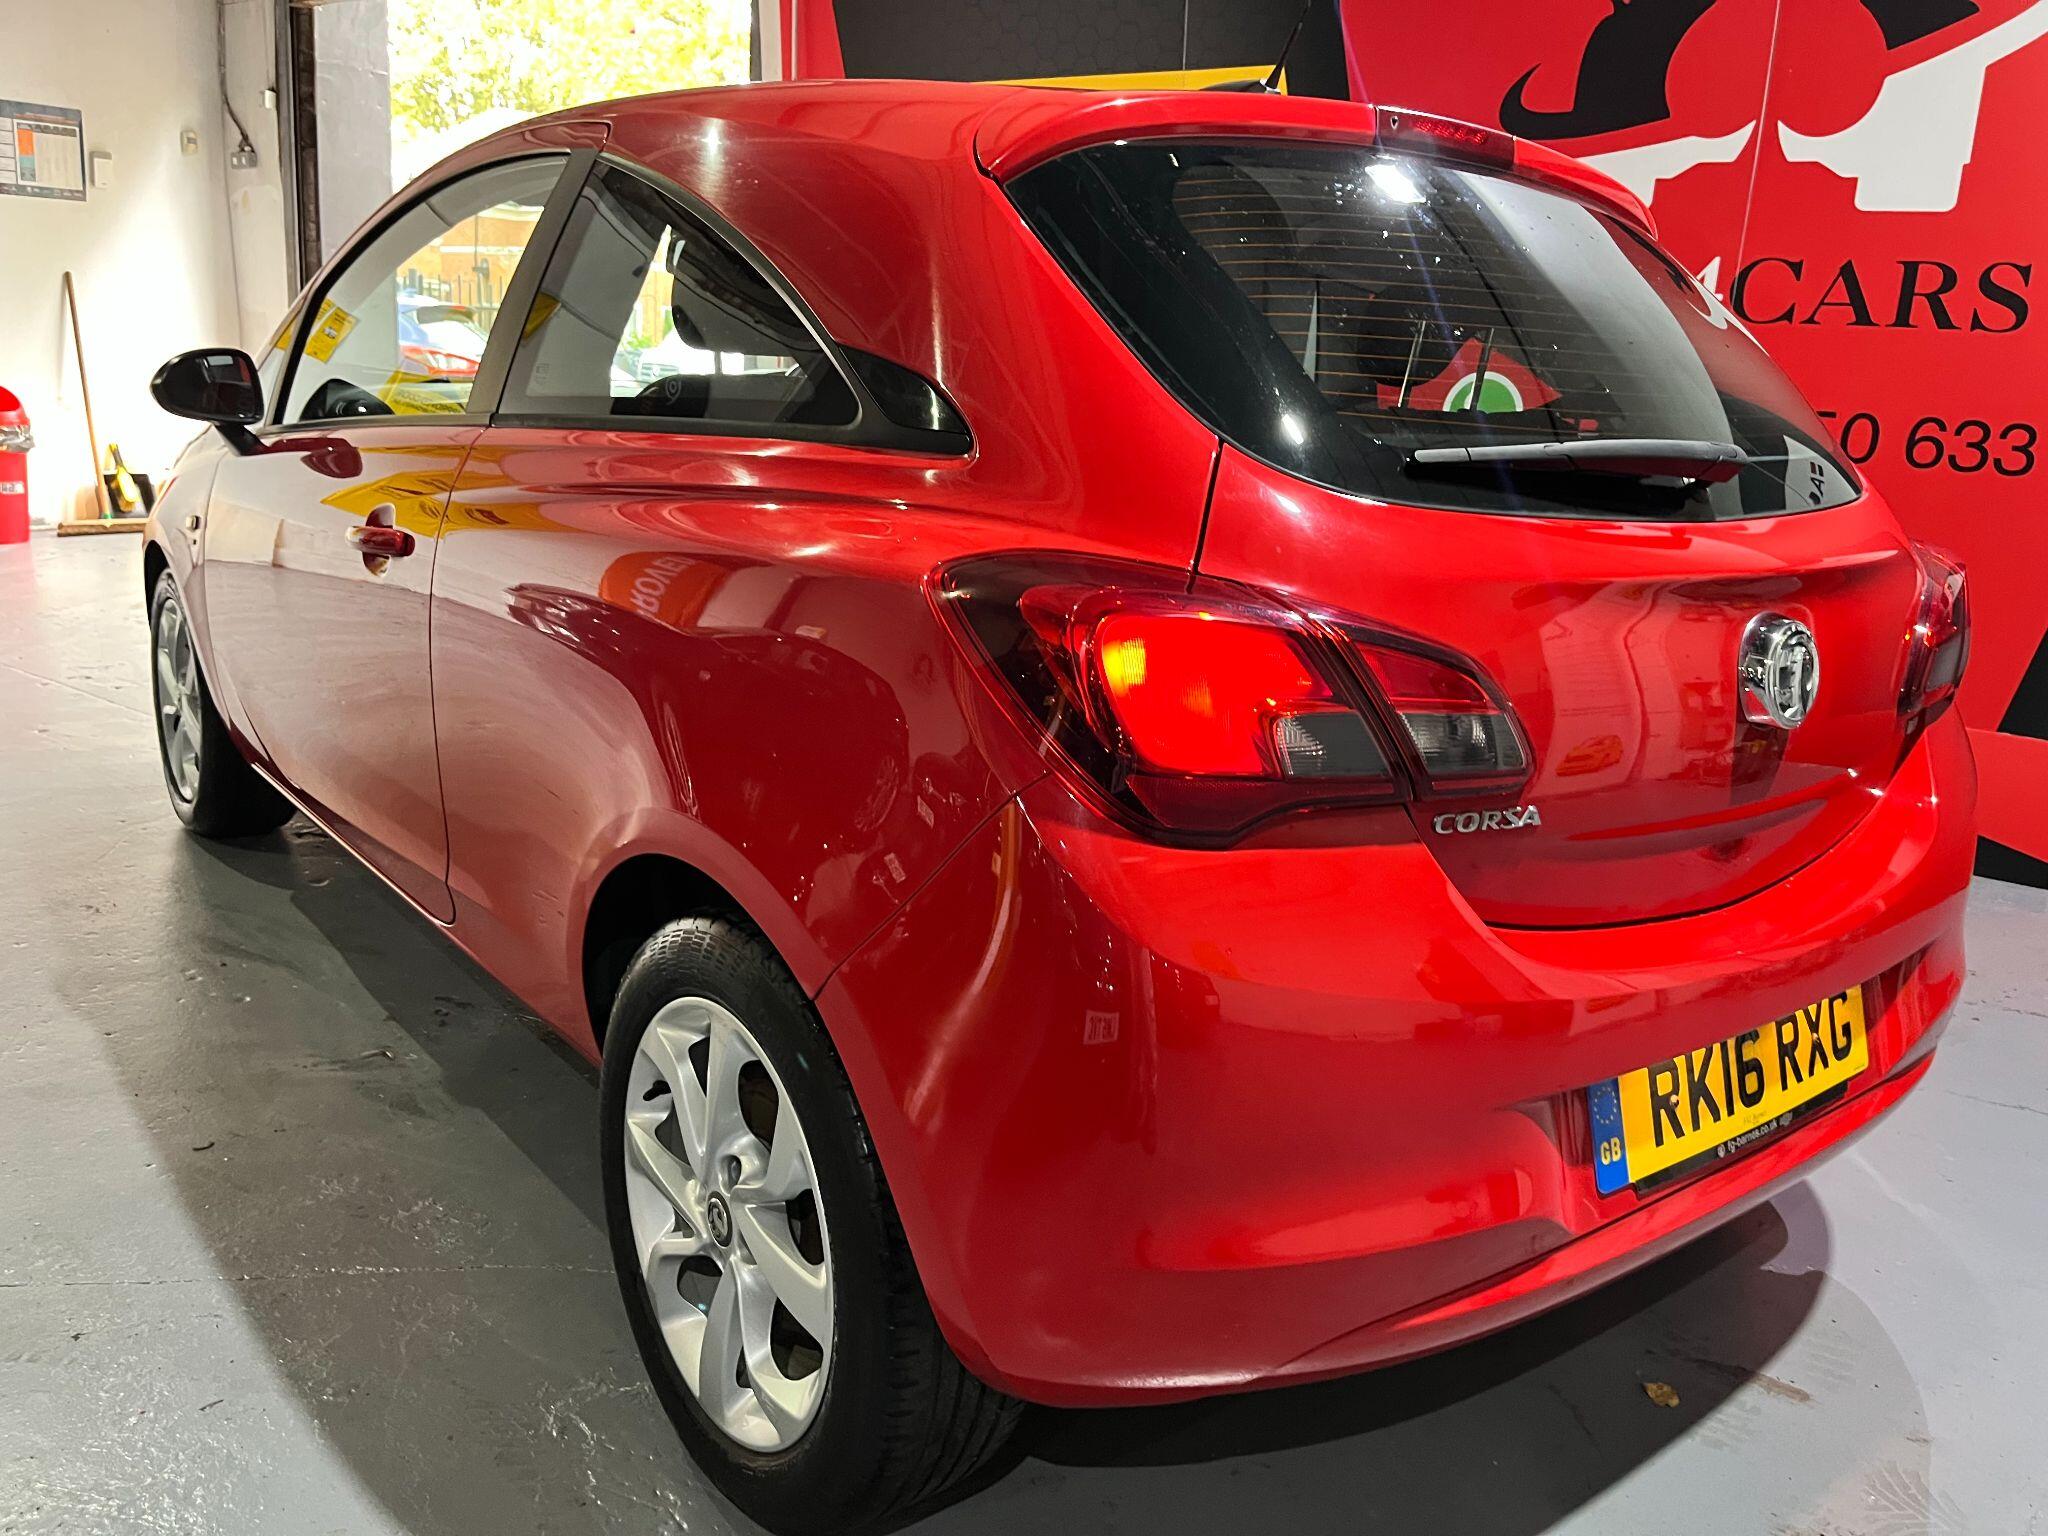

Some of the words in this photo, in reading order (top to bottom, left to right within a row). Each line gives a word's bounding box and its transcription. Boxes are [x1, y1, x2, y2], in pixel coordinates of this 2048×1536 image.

[1730, 257, 2032, 333] CARS
[1816, 410, 1881, 464] 0
[1905, 416, 2038, 476] 633
[1434, 805, 1542, 834] CORSA
[1646, 1030, 1765, 1148] RK16
[1775, 992, 1853, 1092] RXG
[1600, 1137, 1622, 1166] GB
